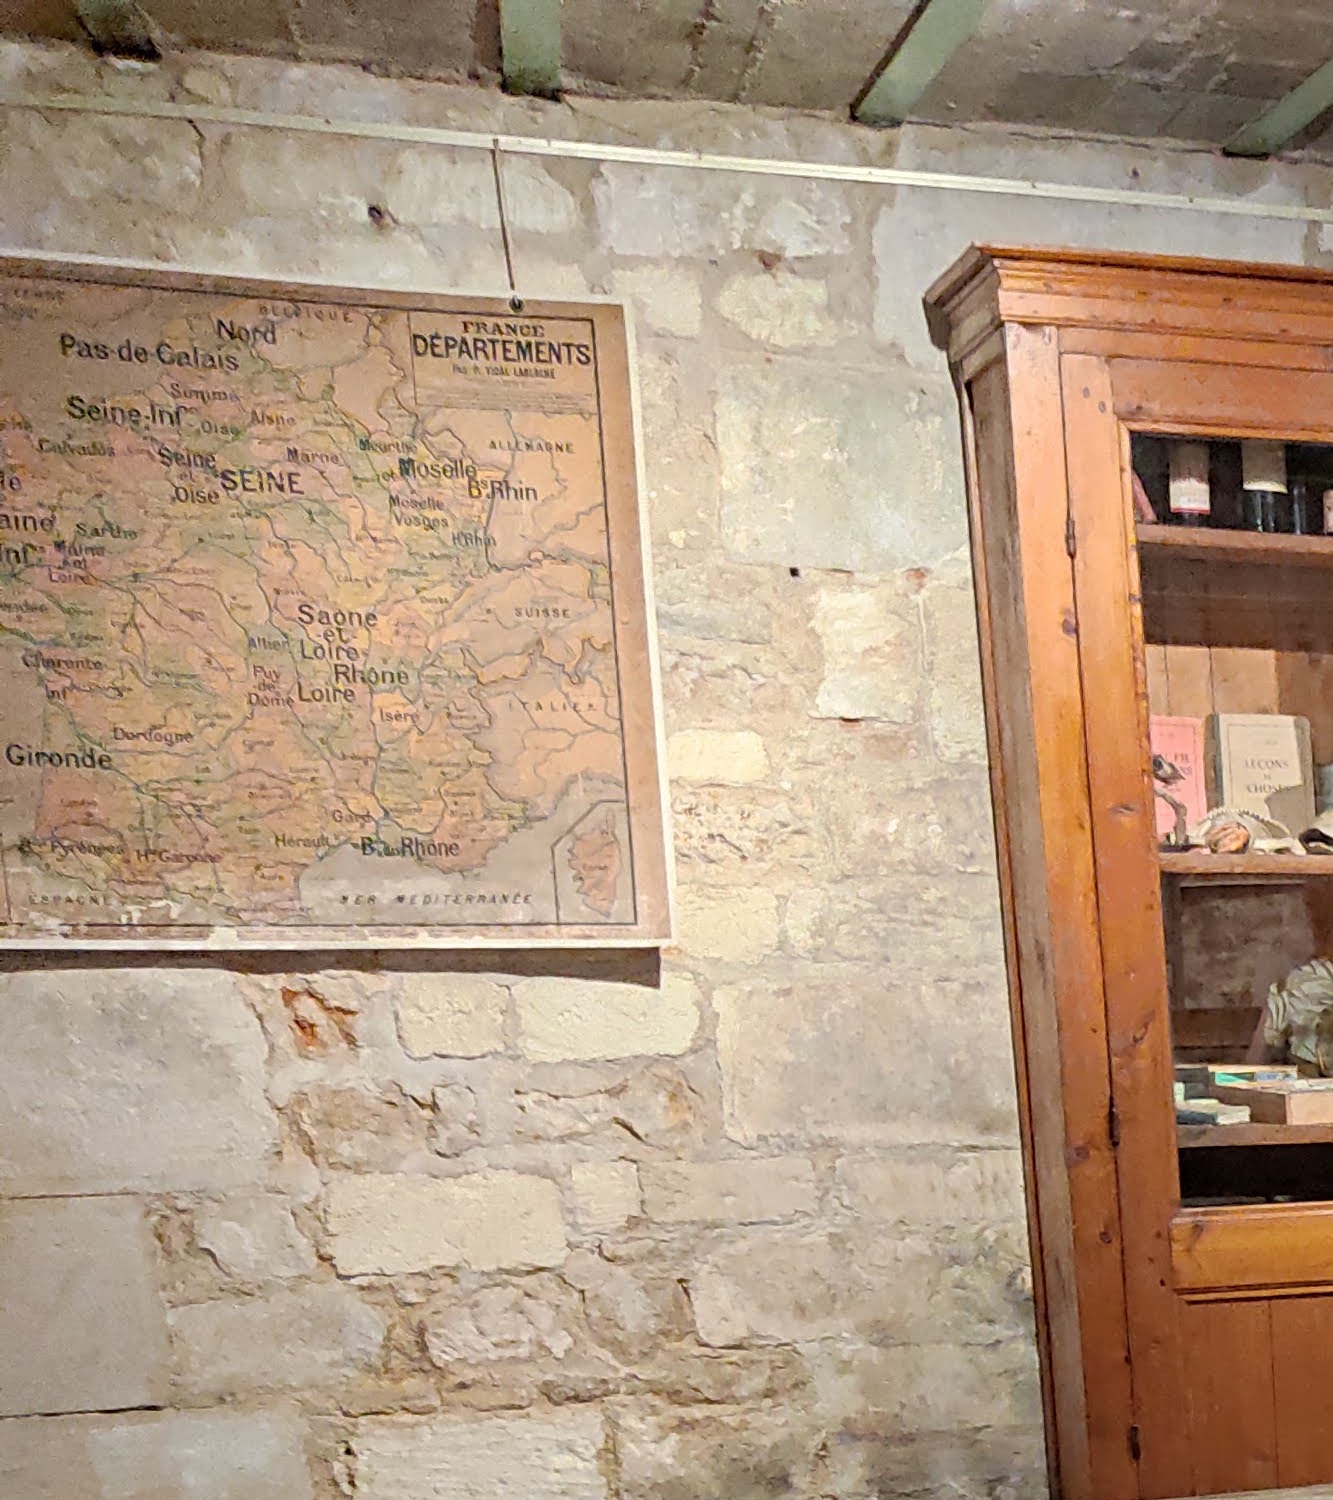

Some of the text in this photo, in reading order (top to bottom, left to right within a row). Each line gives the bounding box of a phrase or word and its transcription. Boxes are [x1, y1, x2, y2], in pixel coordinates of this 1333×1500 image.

[215, 319, 277, 346] Nord
[461, 320, 546, 338] FRANCE
[412, 328, 592, 366] DÉPARTEMENTS
[158, 444, 217, 469] Seine
[286, 446, 340, 466] Marne
[398, 456, 478, 480] Moselle
[219, 468, 306, 496] SEINE
[174, 485, 220, 505] Oise
[513, 606, 572, 620] SUISSE
[300, 638, 360, 662] Loire
[334, 660, 410, 686] Rhône
[297, 680, 356, 704] Loire
[4, 742, 113, 771] Gironde
